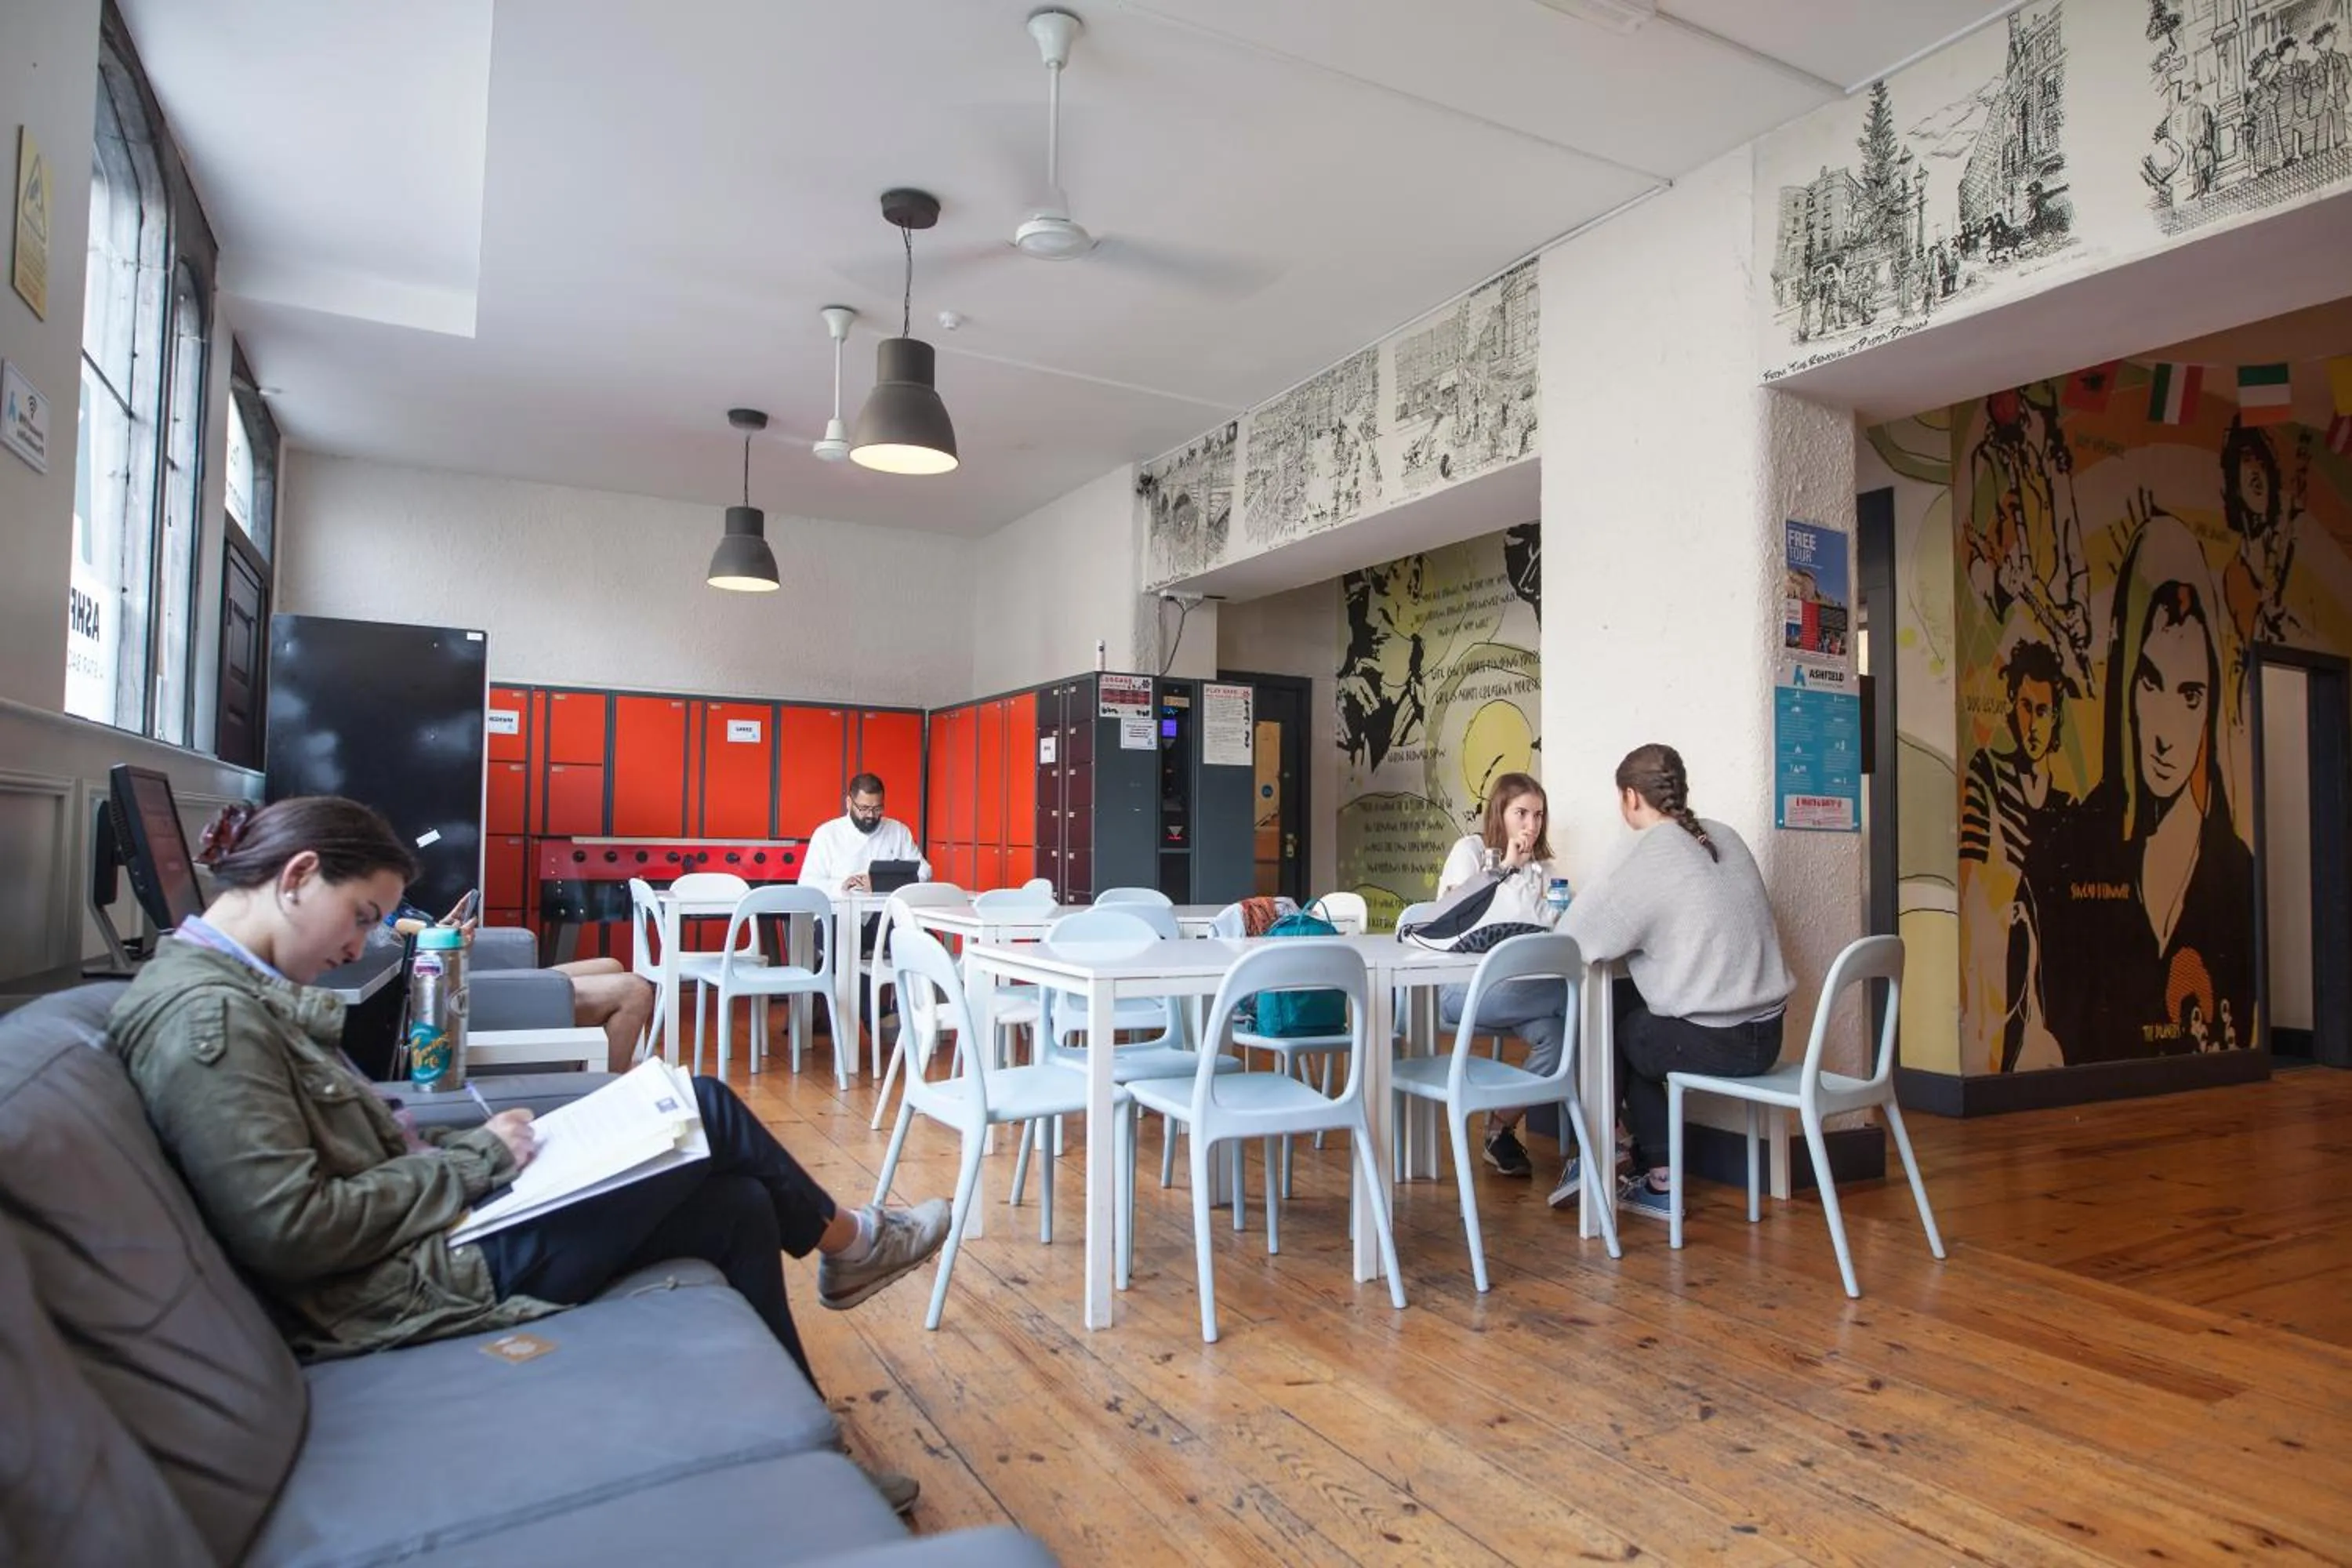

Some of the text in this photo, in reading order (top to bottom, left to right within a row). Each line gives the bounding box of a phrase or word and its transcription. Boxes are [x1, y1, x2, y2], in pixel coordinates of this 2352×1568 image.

[1787, 529, 1817, 551] FREE
[1788, 546, 1813, 563] TOUR
[1809, 669, 1845, 682] ASHFIELD
